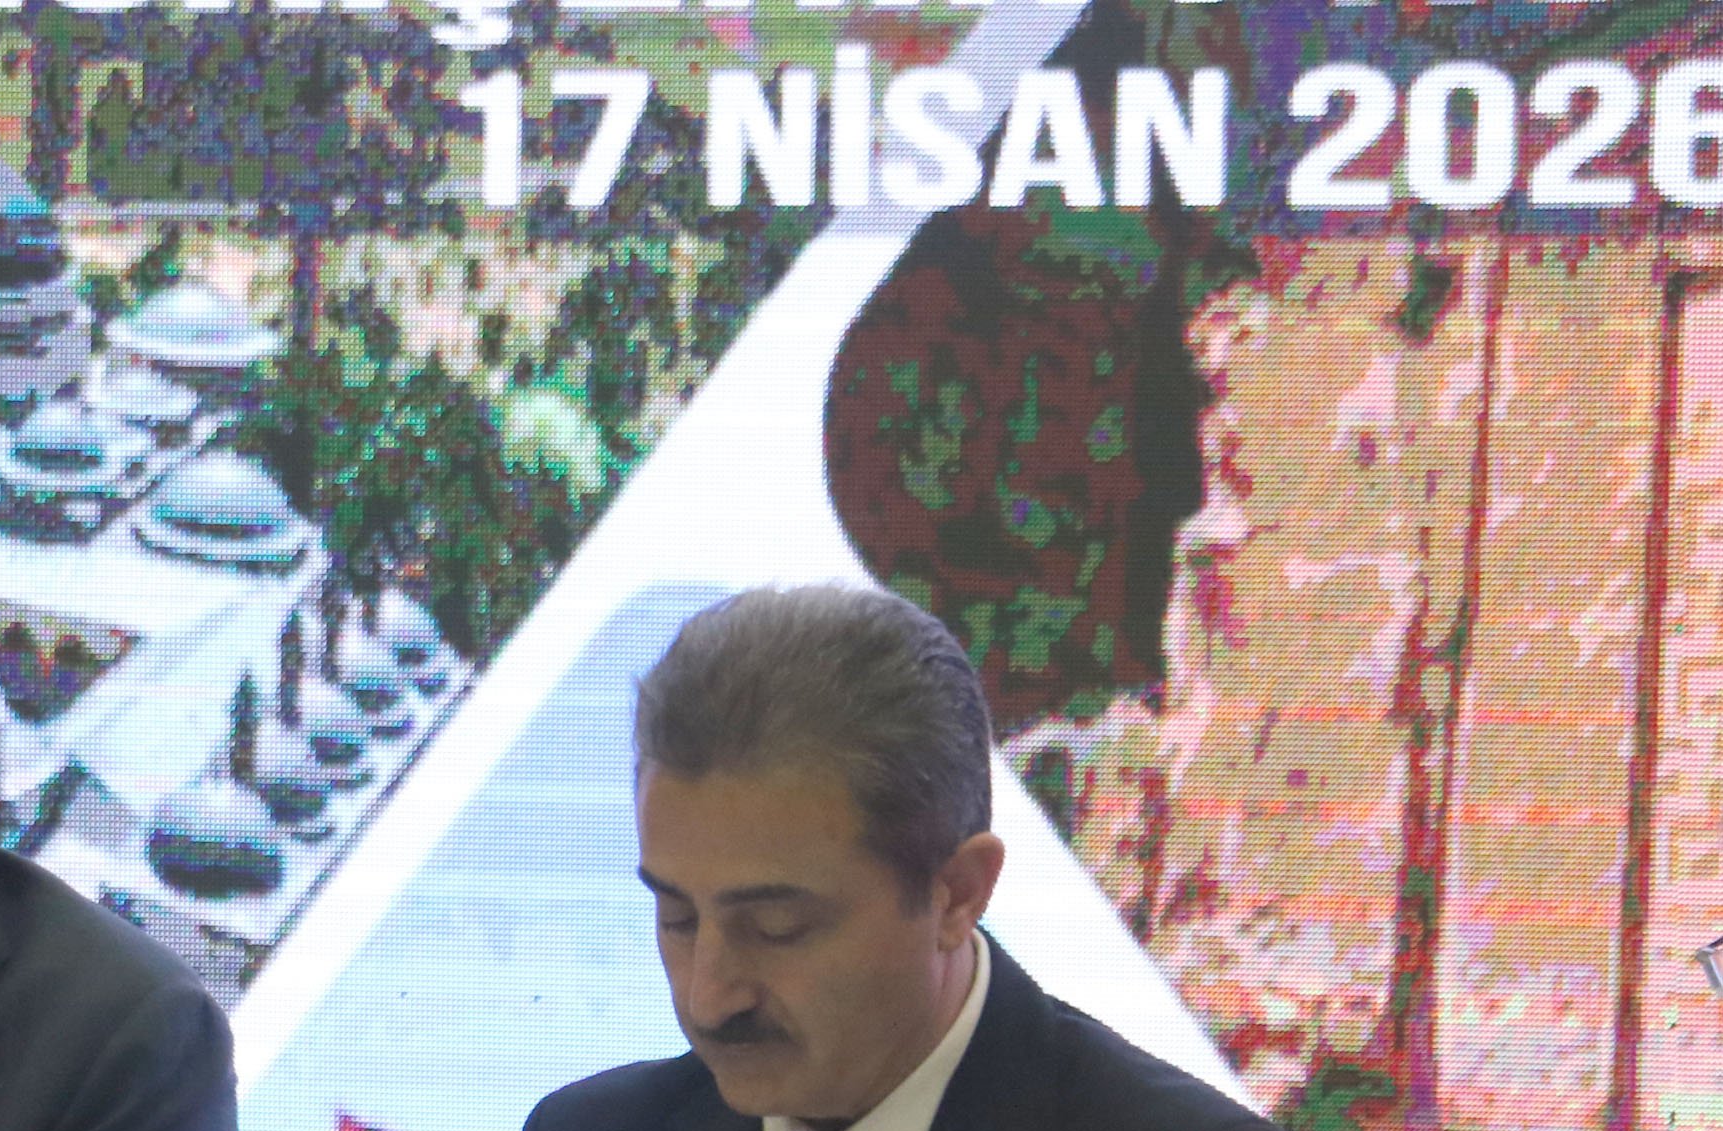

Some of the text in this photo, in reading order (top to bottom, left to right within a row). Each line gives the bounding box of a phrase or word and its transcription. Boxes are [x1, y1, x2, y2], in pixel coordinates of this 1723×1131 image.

[459, 42, 1723, 210] 17 NİSAN 2026
